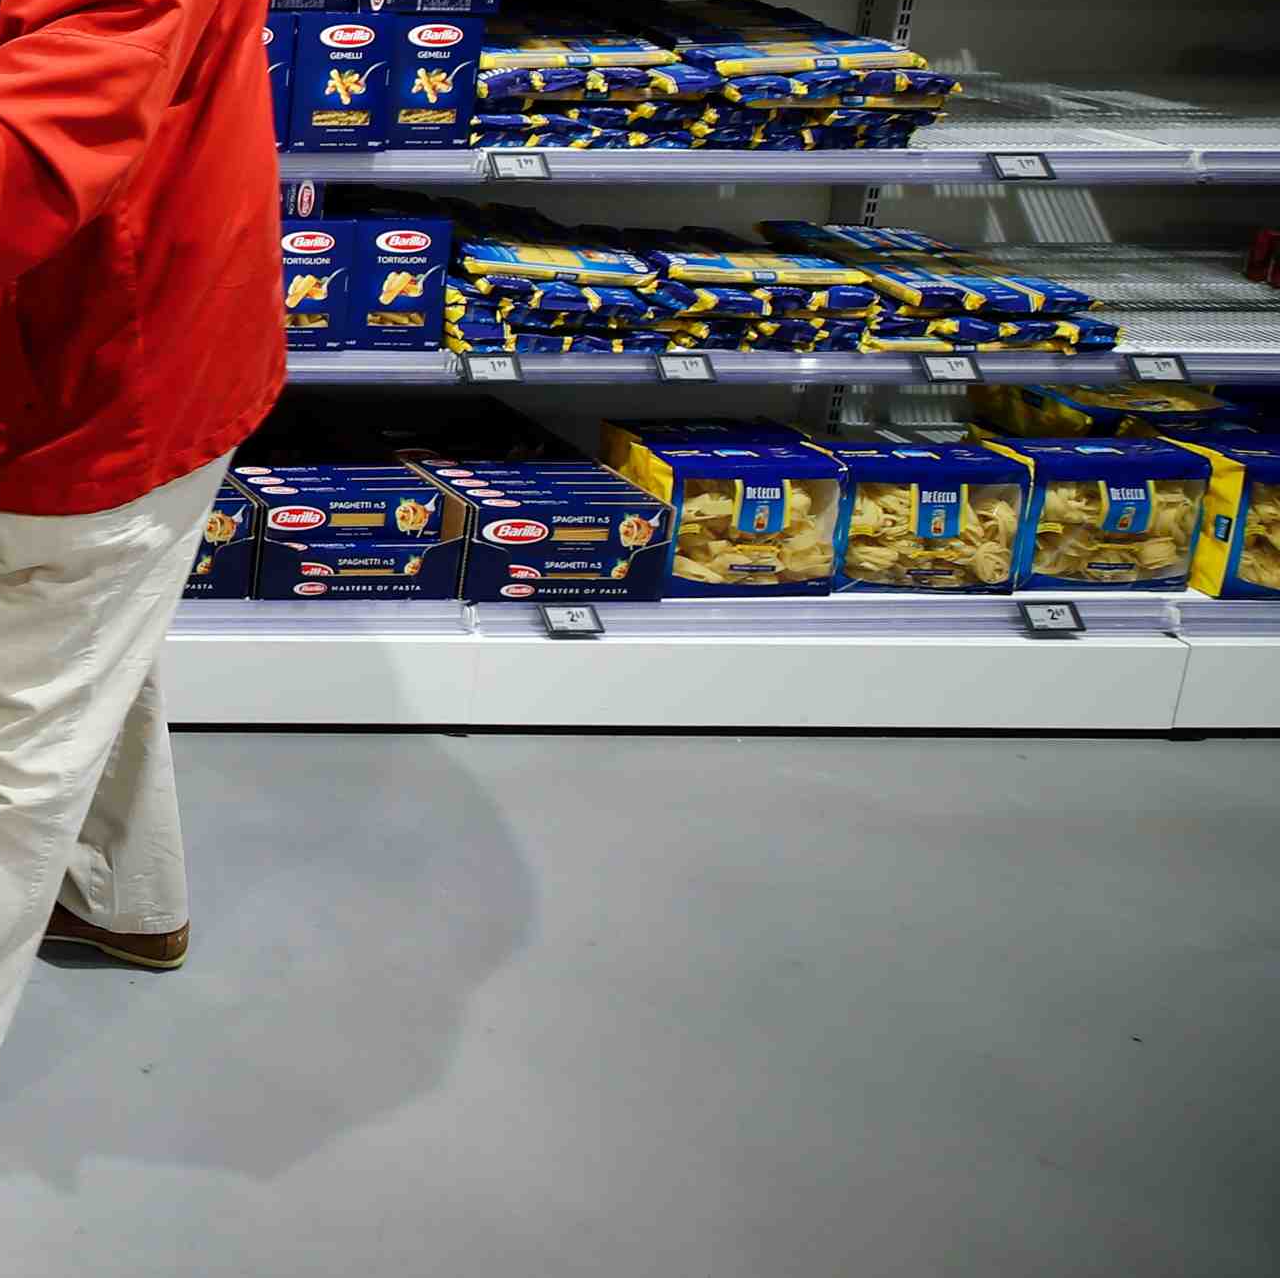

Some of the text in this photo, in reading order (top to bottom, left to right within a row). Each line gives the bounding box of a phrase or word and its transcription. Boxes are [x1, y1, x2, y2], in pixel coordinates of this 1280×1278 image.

[332, 30, 370, 42] Barilla
[329, 52, 363, 60] GEMELLI
[389, 234, 428, 250] Barilla
[376, 256, 427, 264] TORTIGLIONI
[329, 500, 372, 510] SPAGHETTI
[276, 511, 321, 525] Barilla
[551, 515, 596, 524] SPAGHETTI
[496, 525, 544, 539] Barilla
[331, 584, 422, 593] MASTERS OF PASTA
